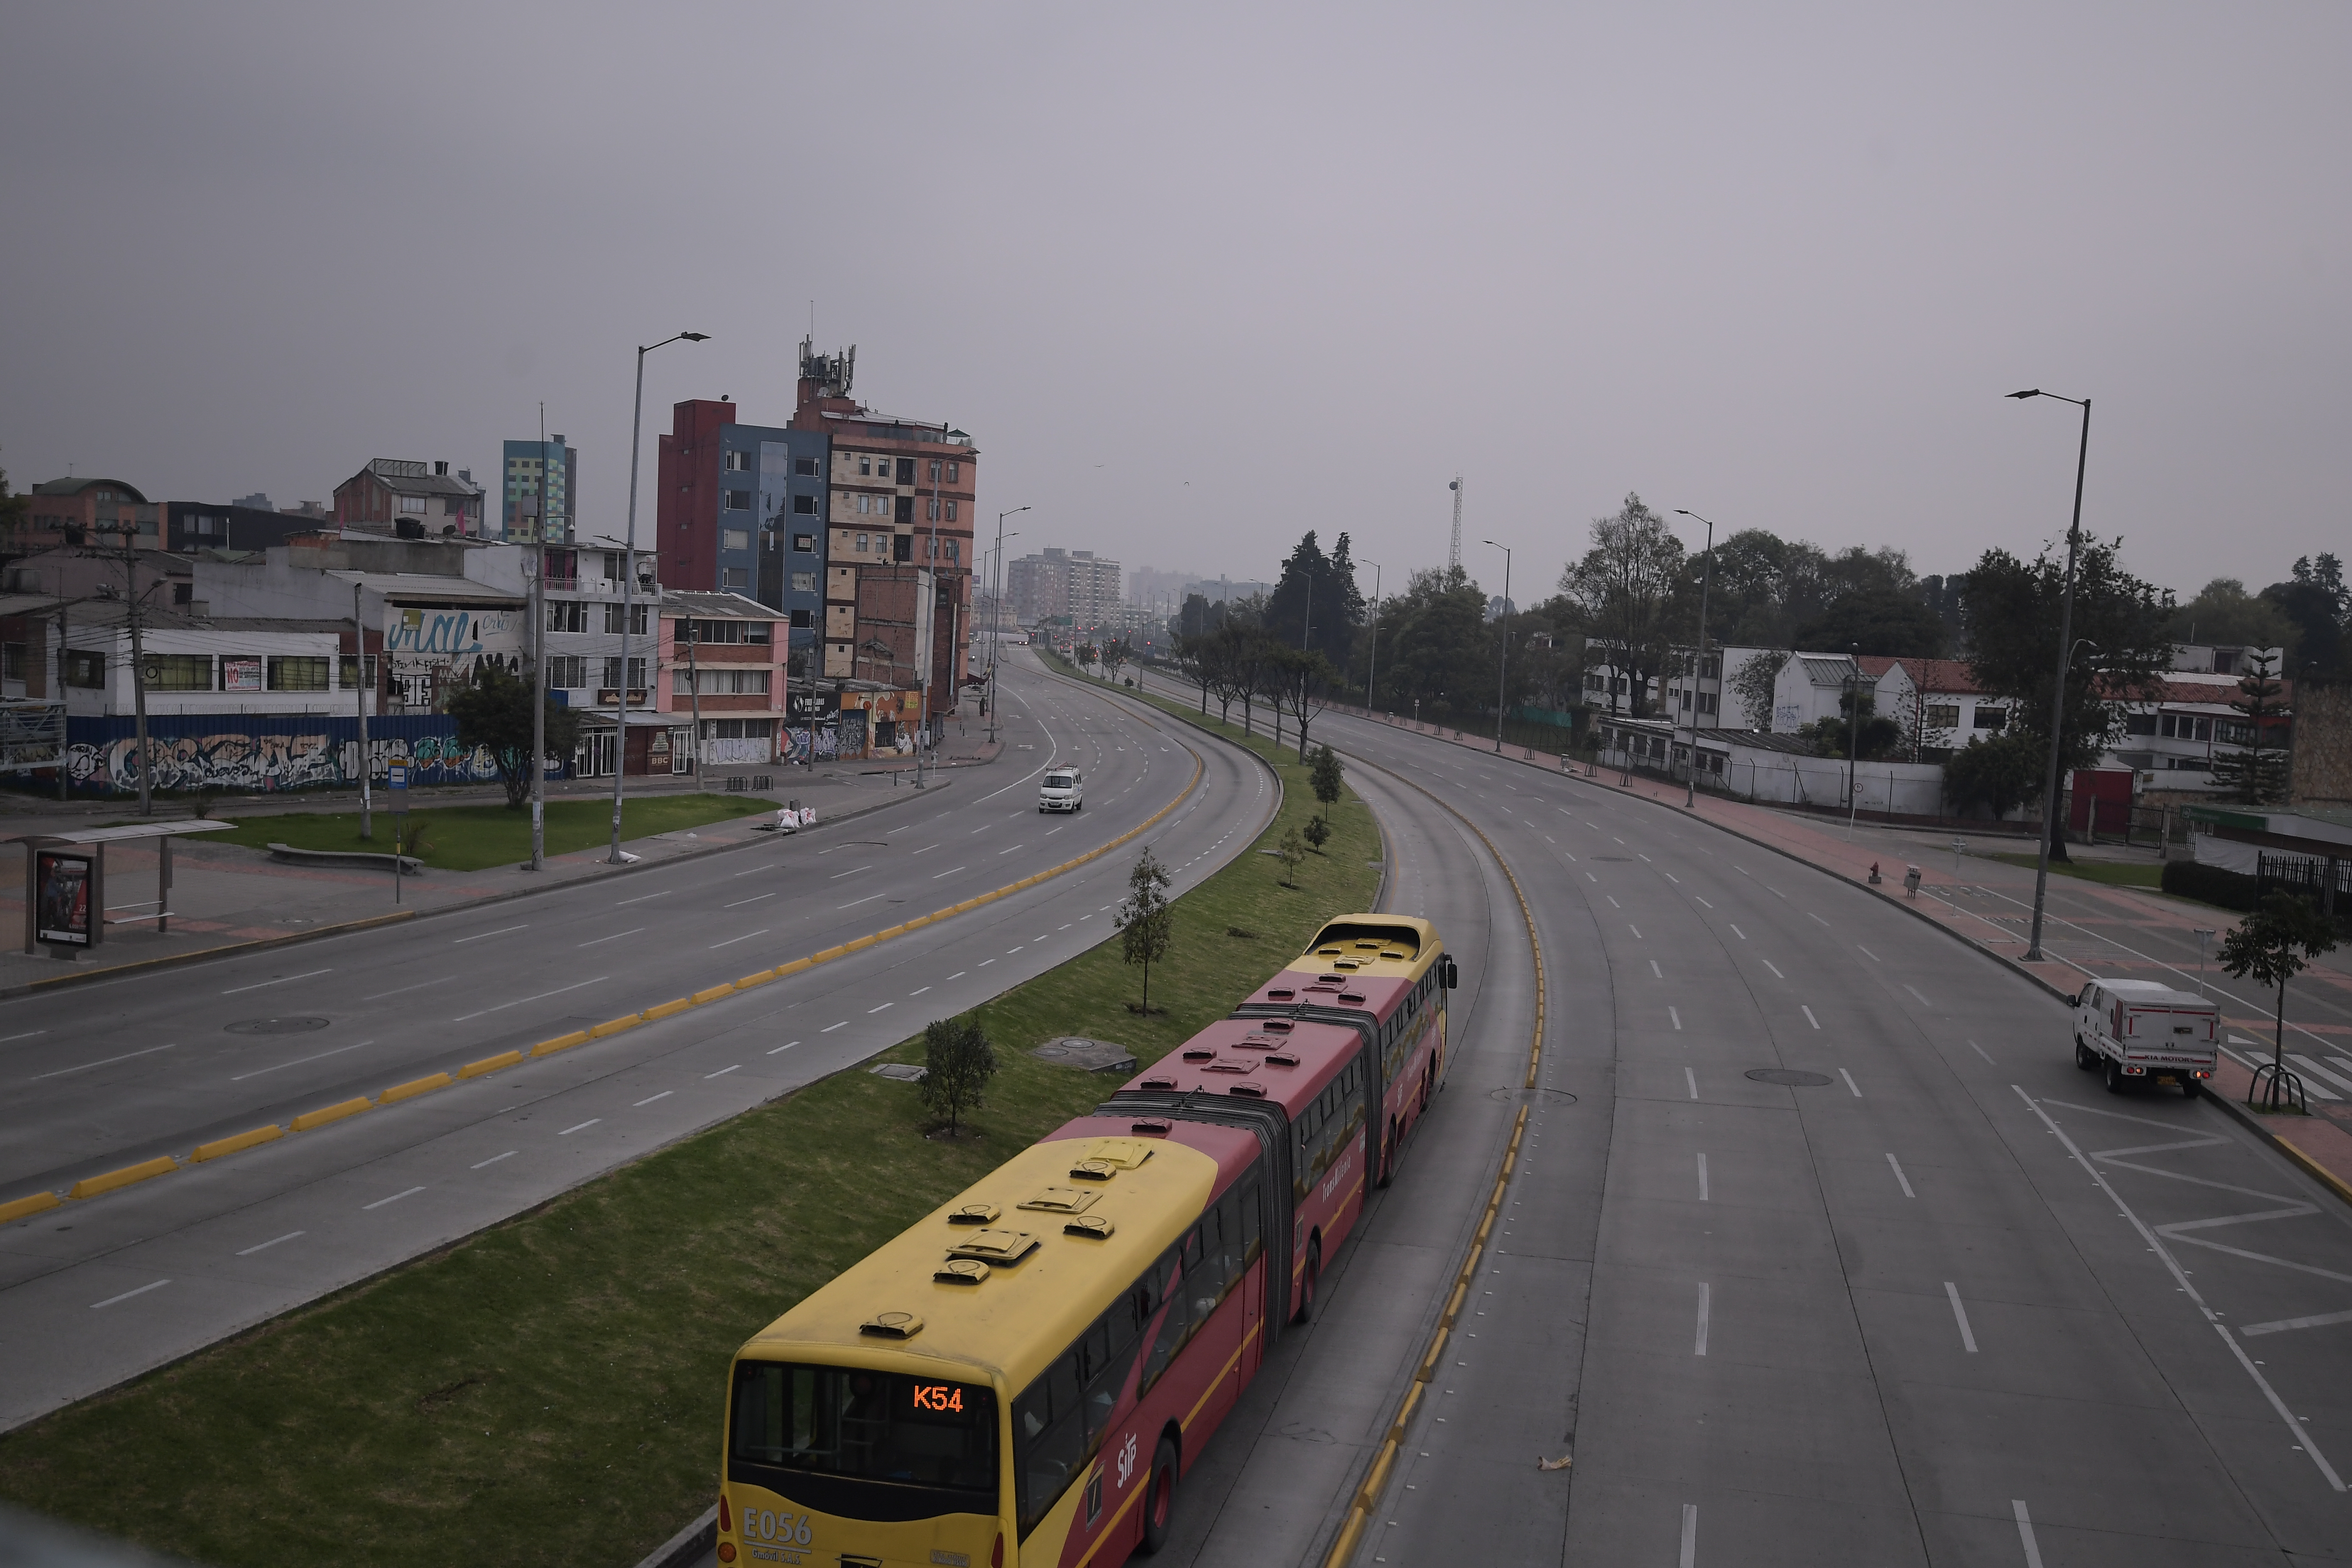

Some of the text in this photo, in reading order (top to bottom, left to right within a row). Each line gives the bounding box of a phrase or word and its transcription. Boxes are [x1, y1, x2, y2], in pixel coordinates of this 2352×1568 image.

[227, 668, 239, 683] NO
[1322, 1154, 1351, 1203] TransMilenio
[914, 1385, 964, 1413] K54
[743, 1506, 812, 1545] E056
[781, 1552, 802, 1565] S.A.S.
